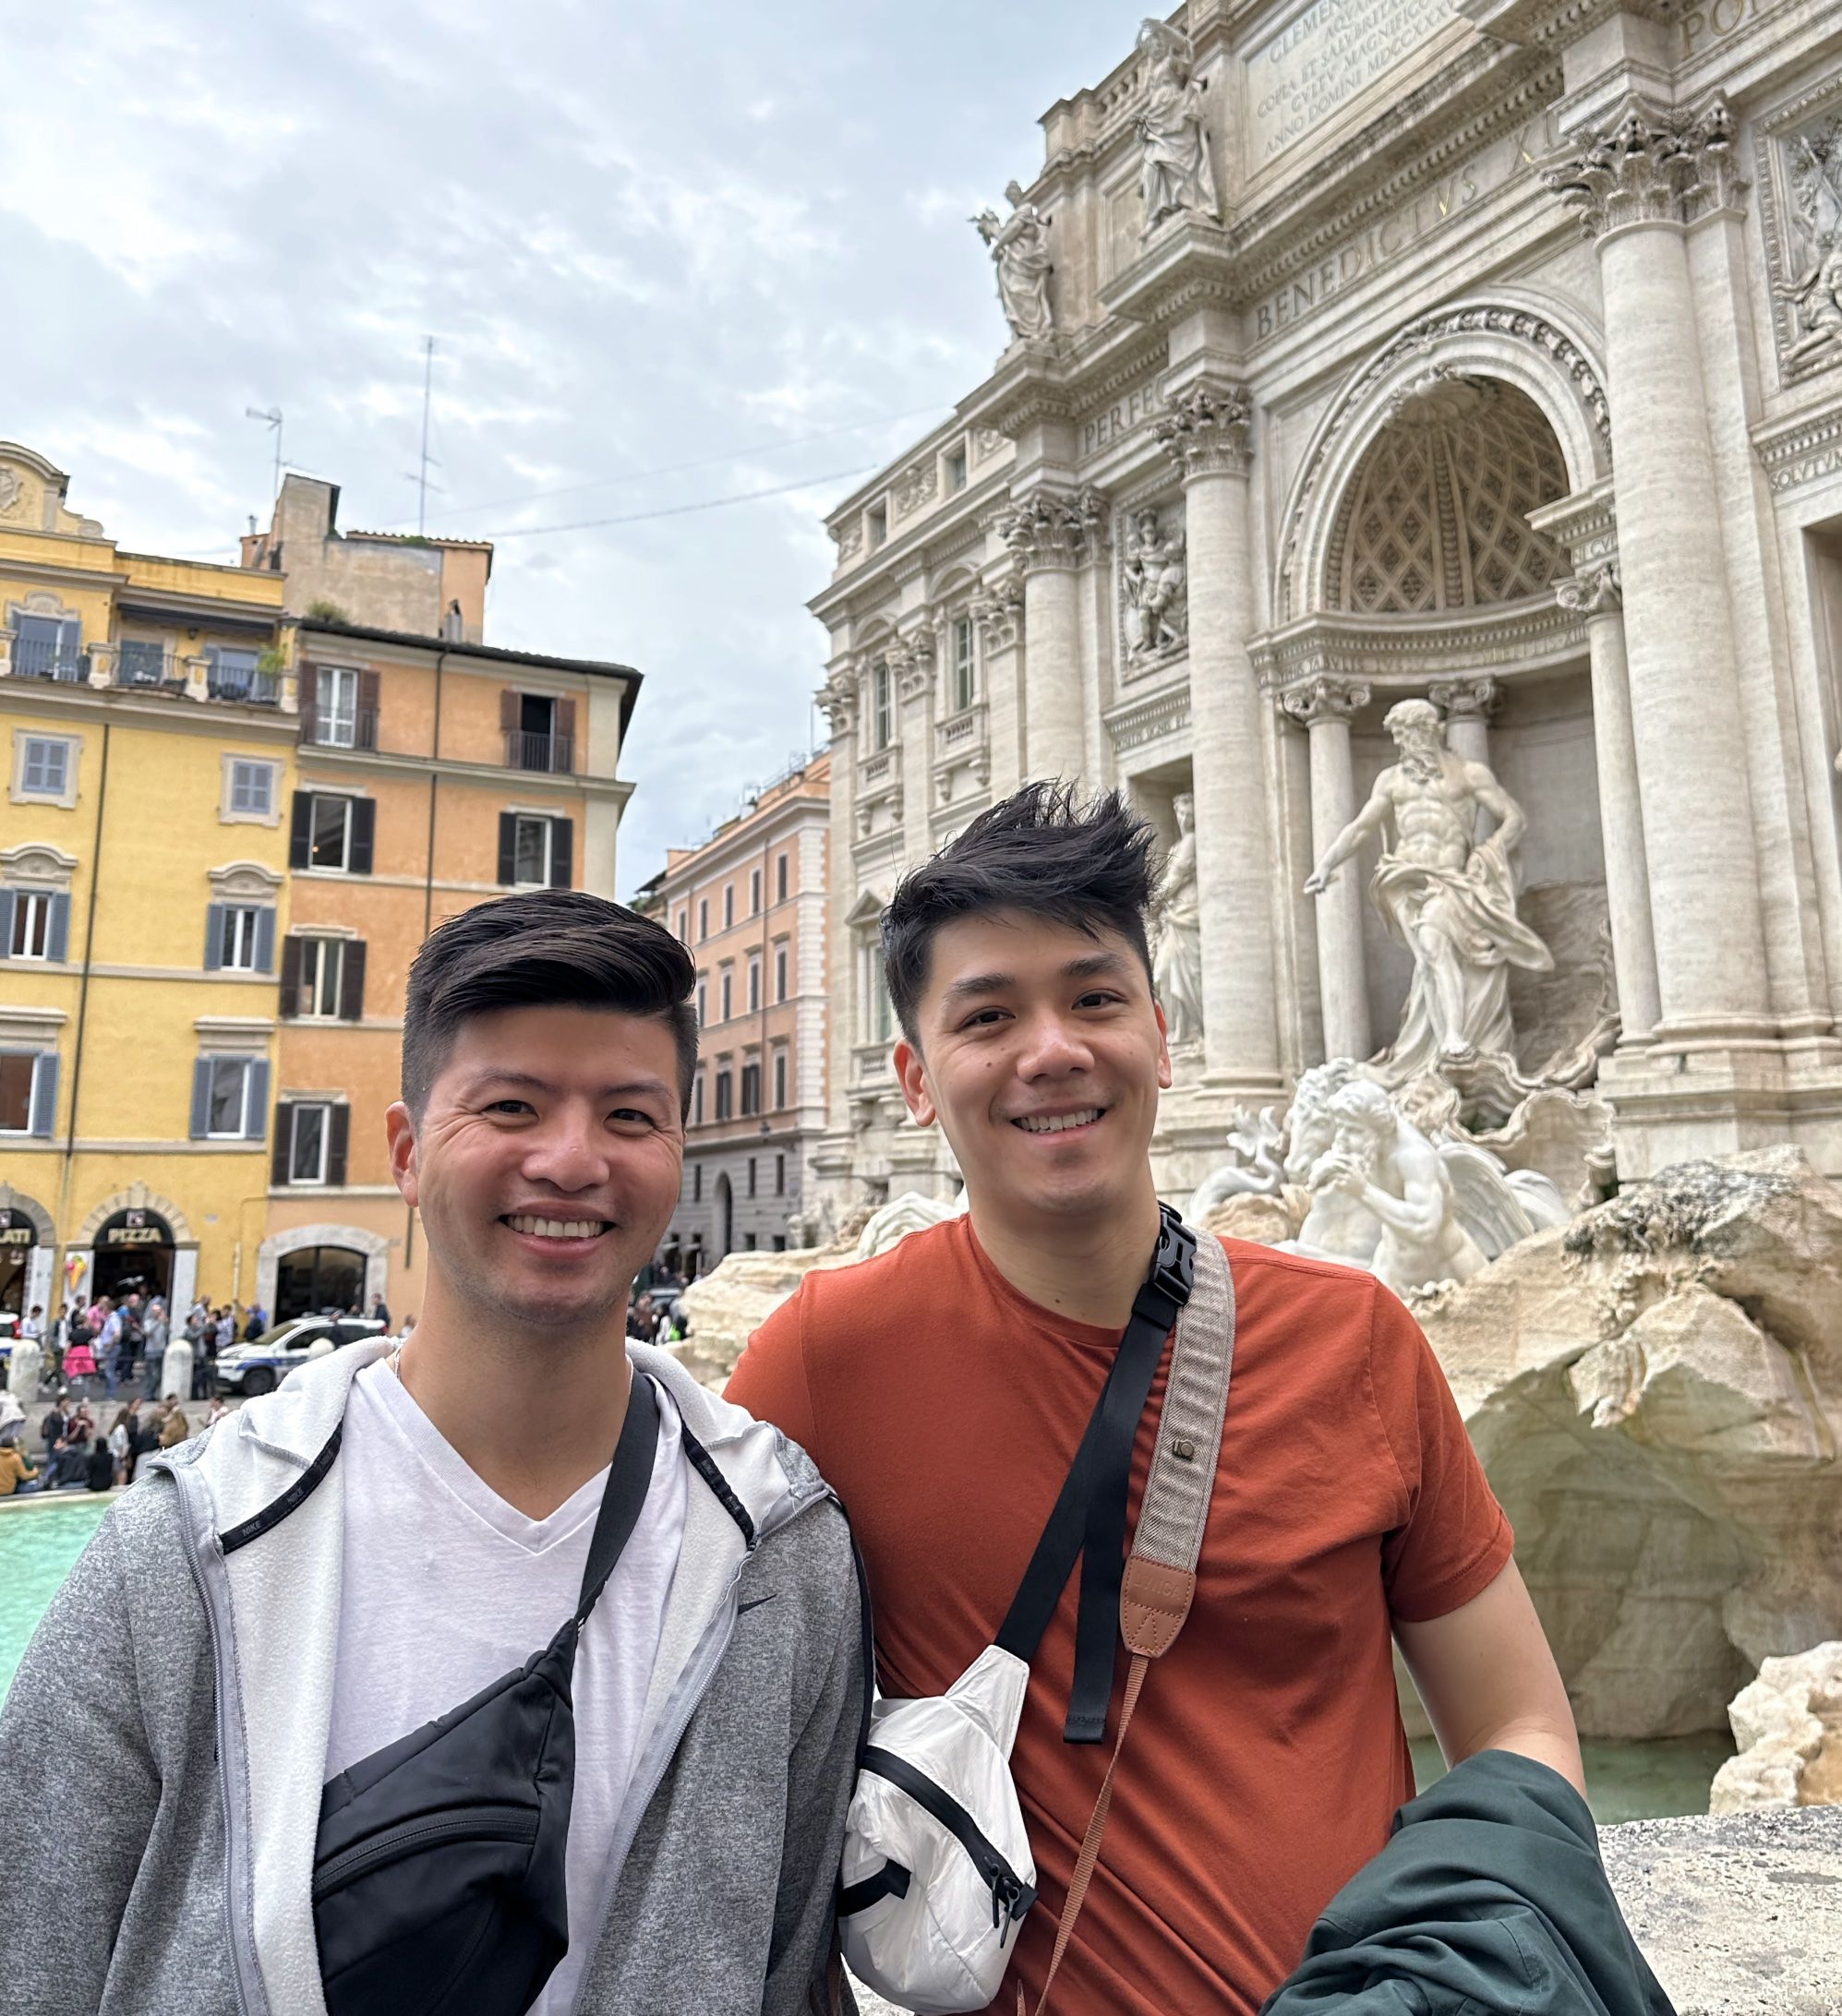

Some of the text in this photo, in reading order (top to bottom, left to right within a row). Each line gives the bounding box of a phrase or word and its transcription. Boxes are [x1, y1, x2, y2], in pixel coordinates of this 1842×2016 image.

[1270, 0, 1347, 64] CLEMEN
[1301, 56, 1318, 83] ET
[1263, 115, 1305, 155] ANNO
[1307, 69, 1362, 123] DOMINI
[1255, 164, 1478, 342] BENEDICTVS
[0, 1229, 31, 1244] ATI
[108, 1228, 163, 1243] PIZZA
[242, 1520, 262, 1537] NIKE
